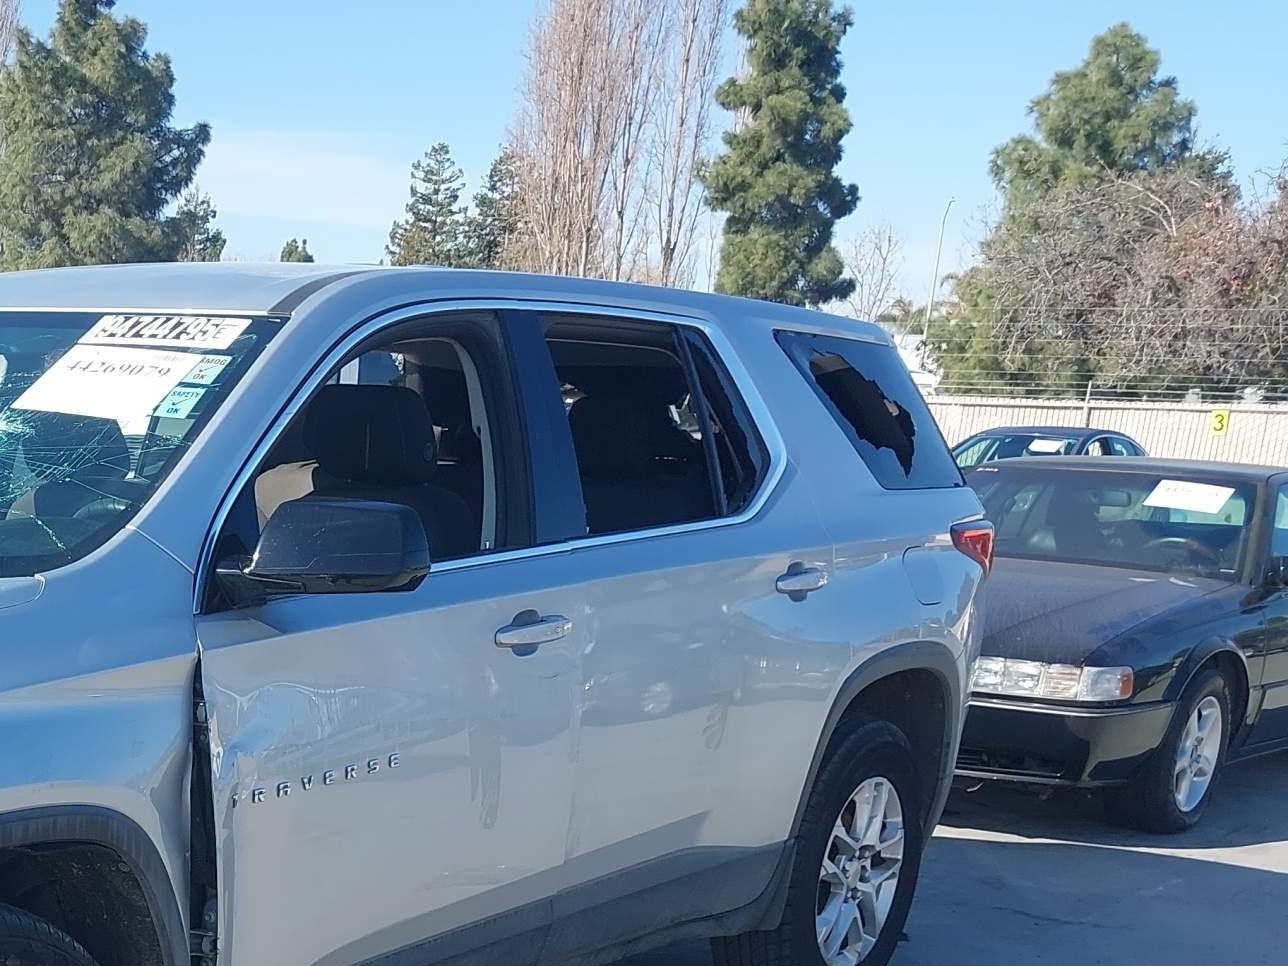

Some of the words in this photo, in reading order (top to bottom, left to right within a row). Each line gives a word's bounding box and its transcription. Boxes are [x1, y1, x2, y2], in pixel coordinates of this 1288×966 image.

[170, 390, 202, 399] SAFETY
[166, 407, 181, 415] OK
[1213, 414, 1225, 431] 3
[231, 752, 402, 809] TRAVERSE
